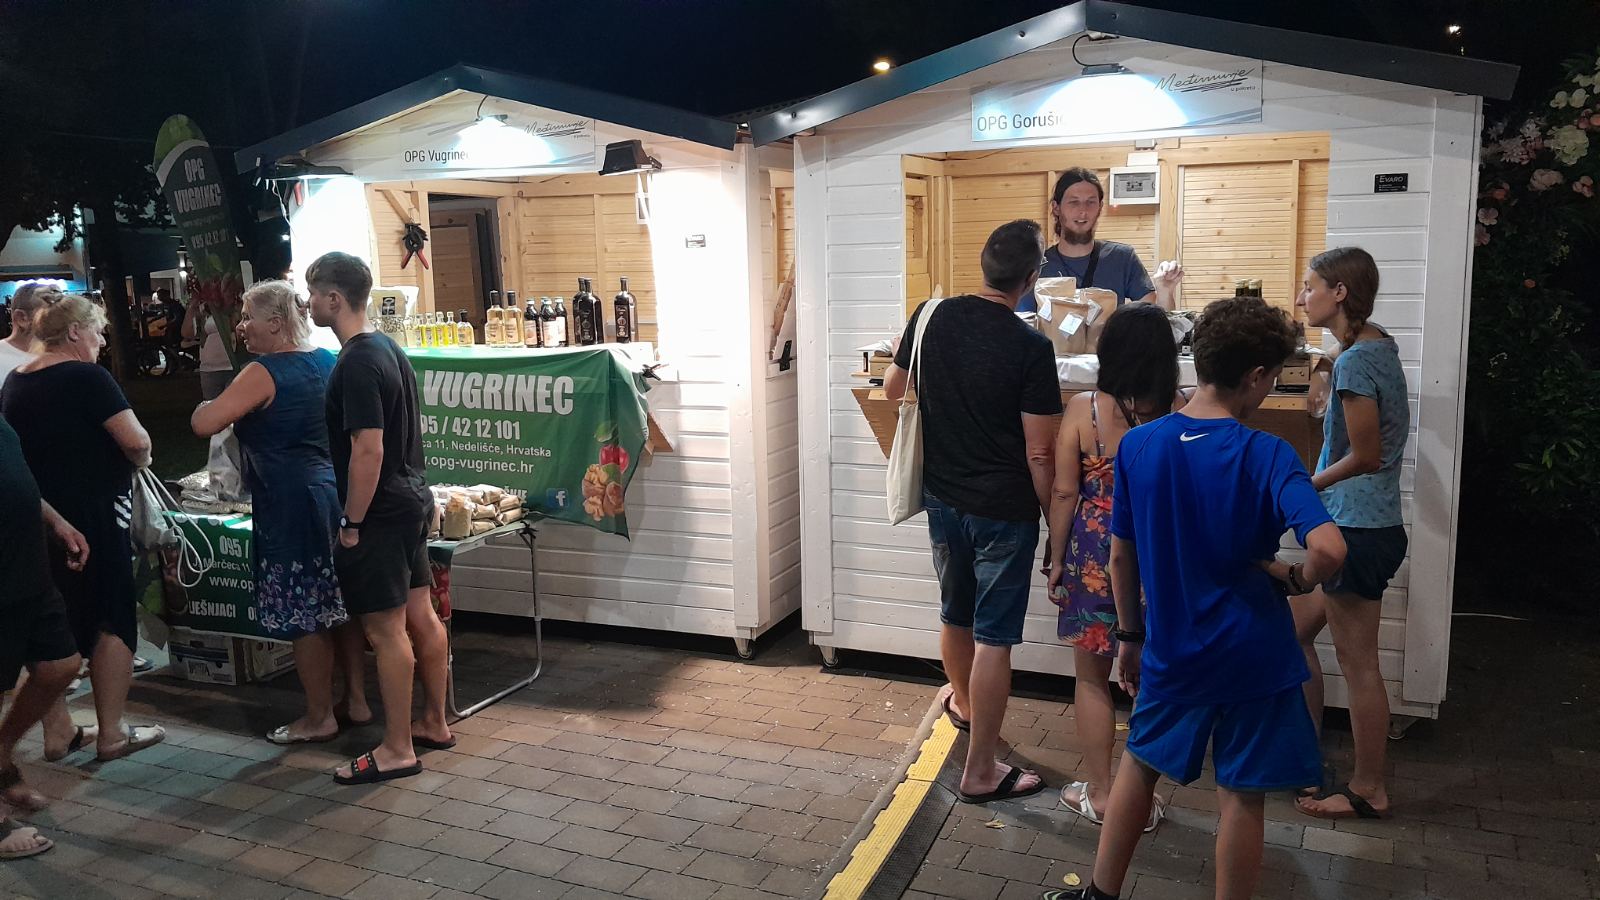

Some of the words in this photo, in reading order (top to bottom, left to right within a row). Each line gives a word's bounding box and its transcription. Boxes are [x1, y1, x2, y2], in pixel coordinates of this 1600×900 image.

[977, 114, 1008, 132] OPG
[404, 149, 426, 163] OPG
[184, 158, 206, 183] OPG
[174, 183, 221, 213] VUGRINEC
[423, 369, 574, 415] VUGRINEC
[452, 417, 471, 437] 42
[474, 418, 492, 438] 12
[494, 420, 521, 440] 101
[435, 438, 449, 451] 11,
[451, 440, 504, 455] Nedelišće,
[506, 446, 552, 458] Hrvatska
[219, 535, 242, 558] 095
